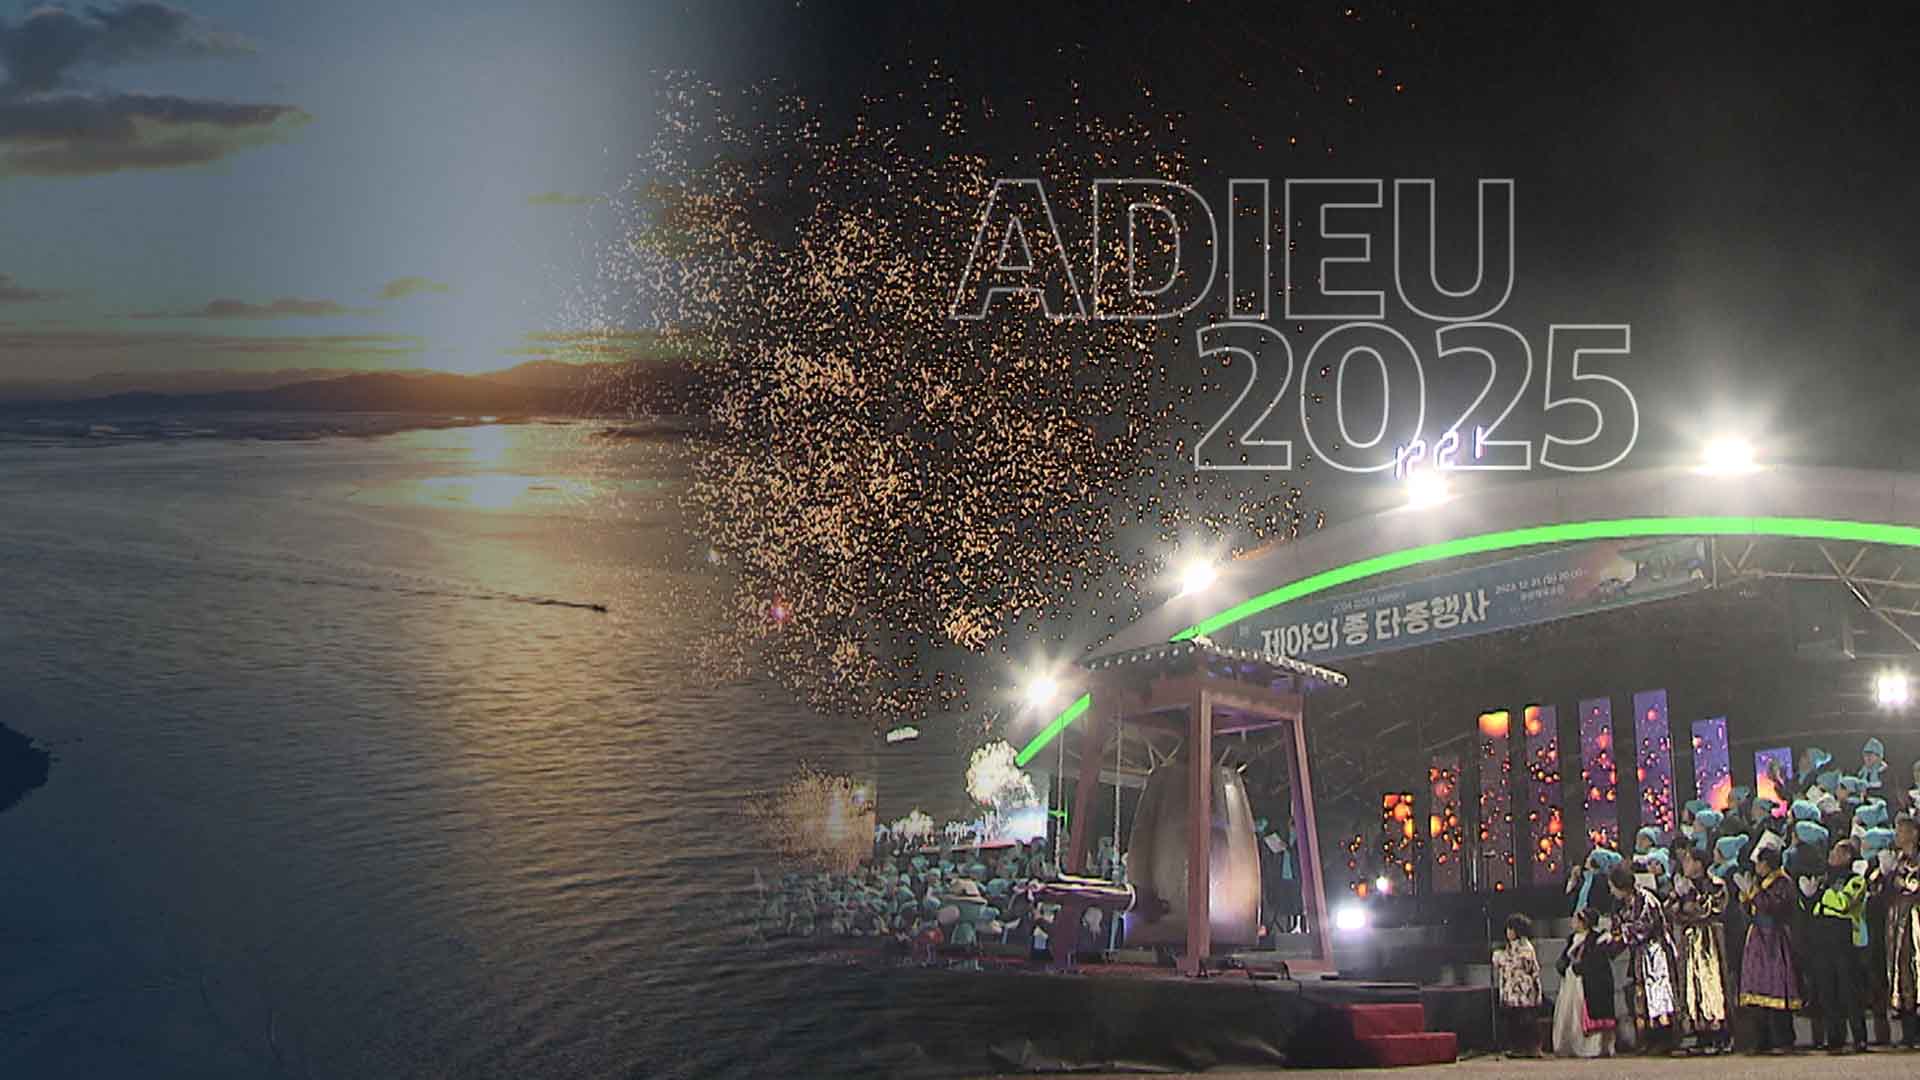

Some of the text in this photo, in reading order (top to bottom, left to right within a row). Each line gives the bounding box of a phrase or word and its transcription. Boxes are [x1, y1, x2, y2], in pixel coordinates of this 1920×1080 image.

[1261, 617, 1338, 658] 제야의
[1342, 611, 1369, 645] 종
[1375, 589, 1490, 640] 타종행사
